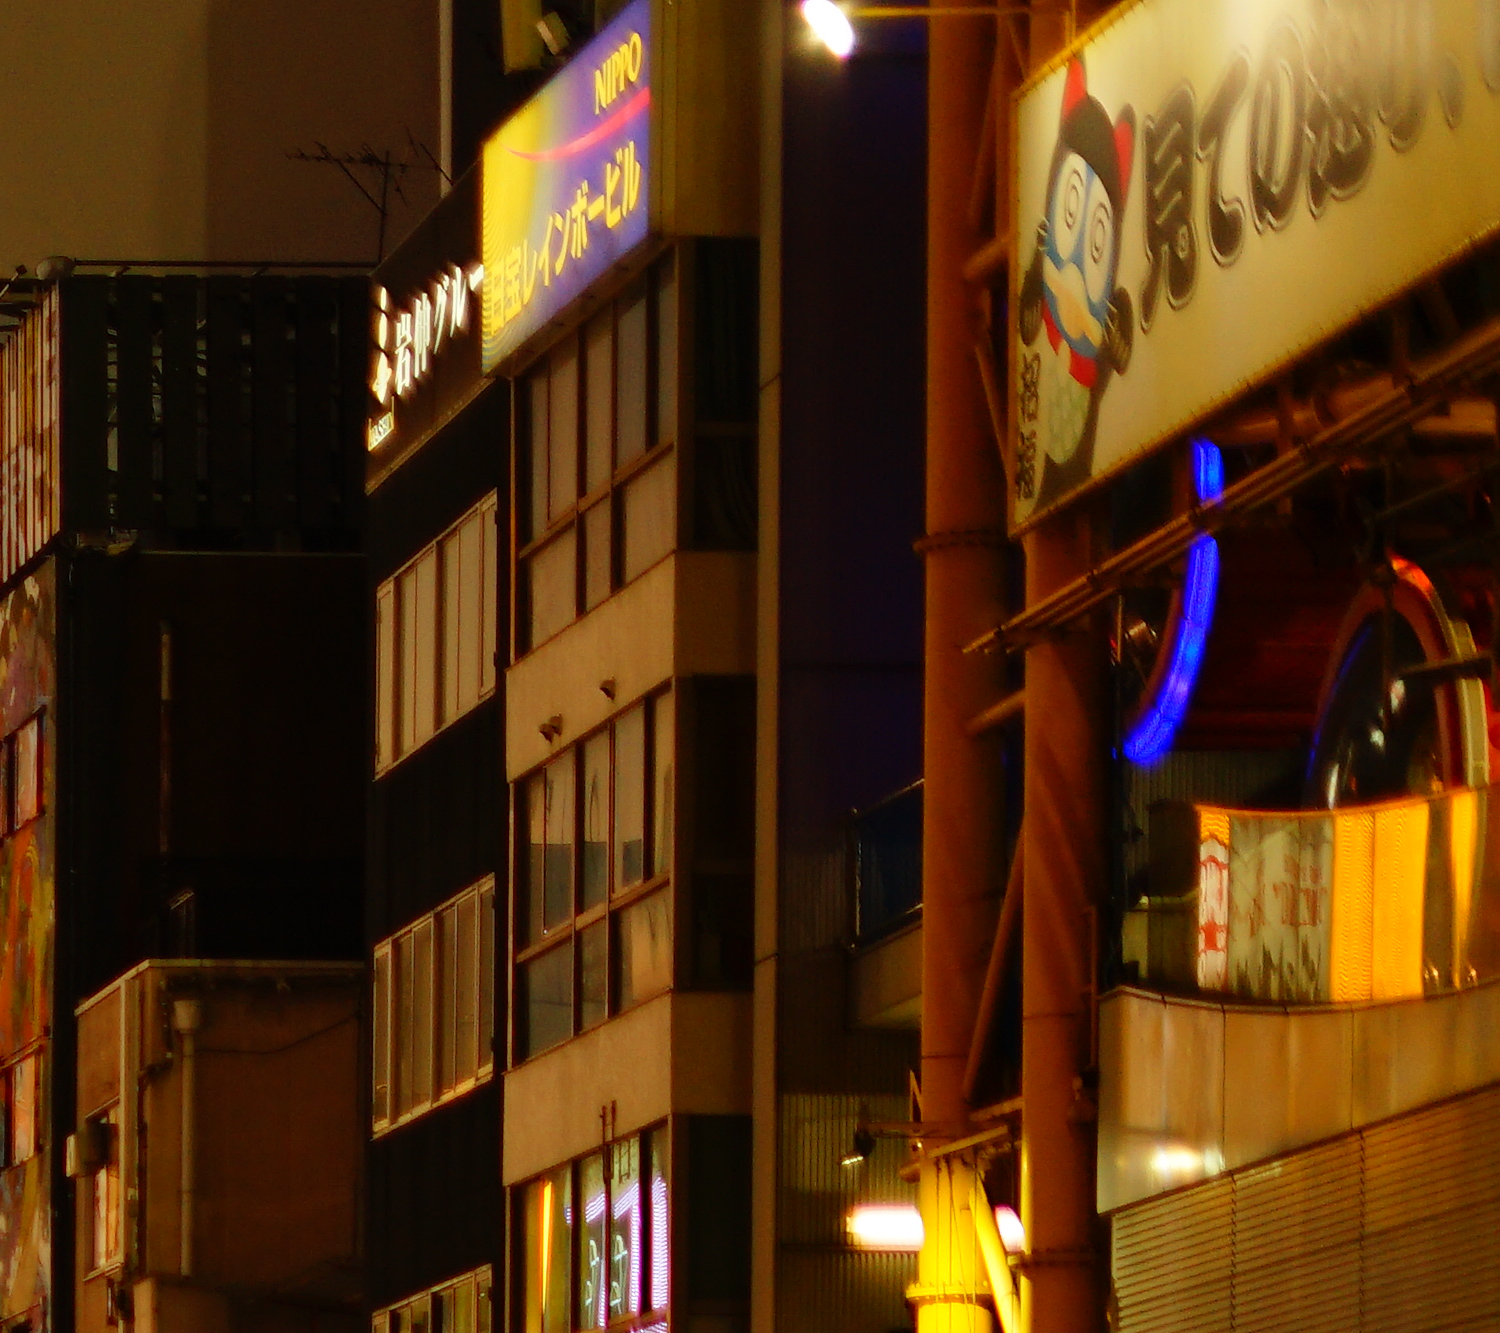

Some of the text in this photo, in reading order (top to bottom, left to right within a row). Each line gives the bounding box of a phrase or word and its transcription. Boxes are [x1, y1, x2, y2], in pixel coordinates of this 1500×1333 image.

[594, 32, 642, 115] NIPPO
[486, 140, 642, 338] 日宝レインボービル
